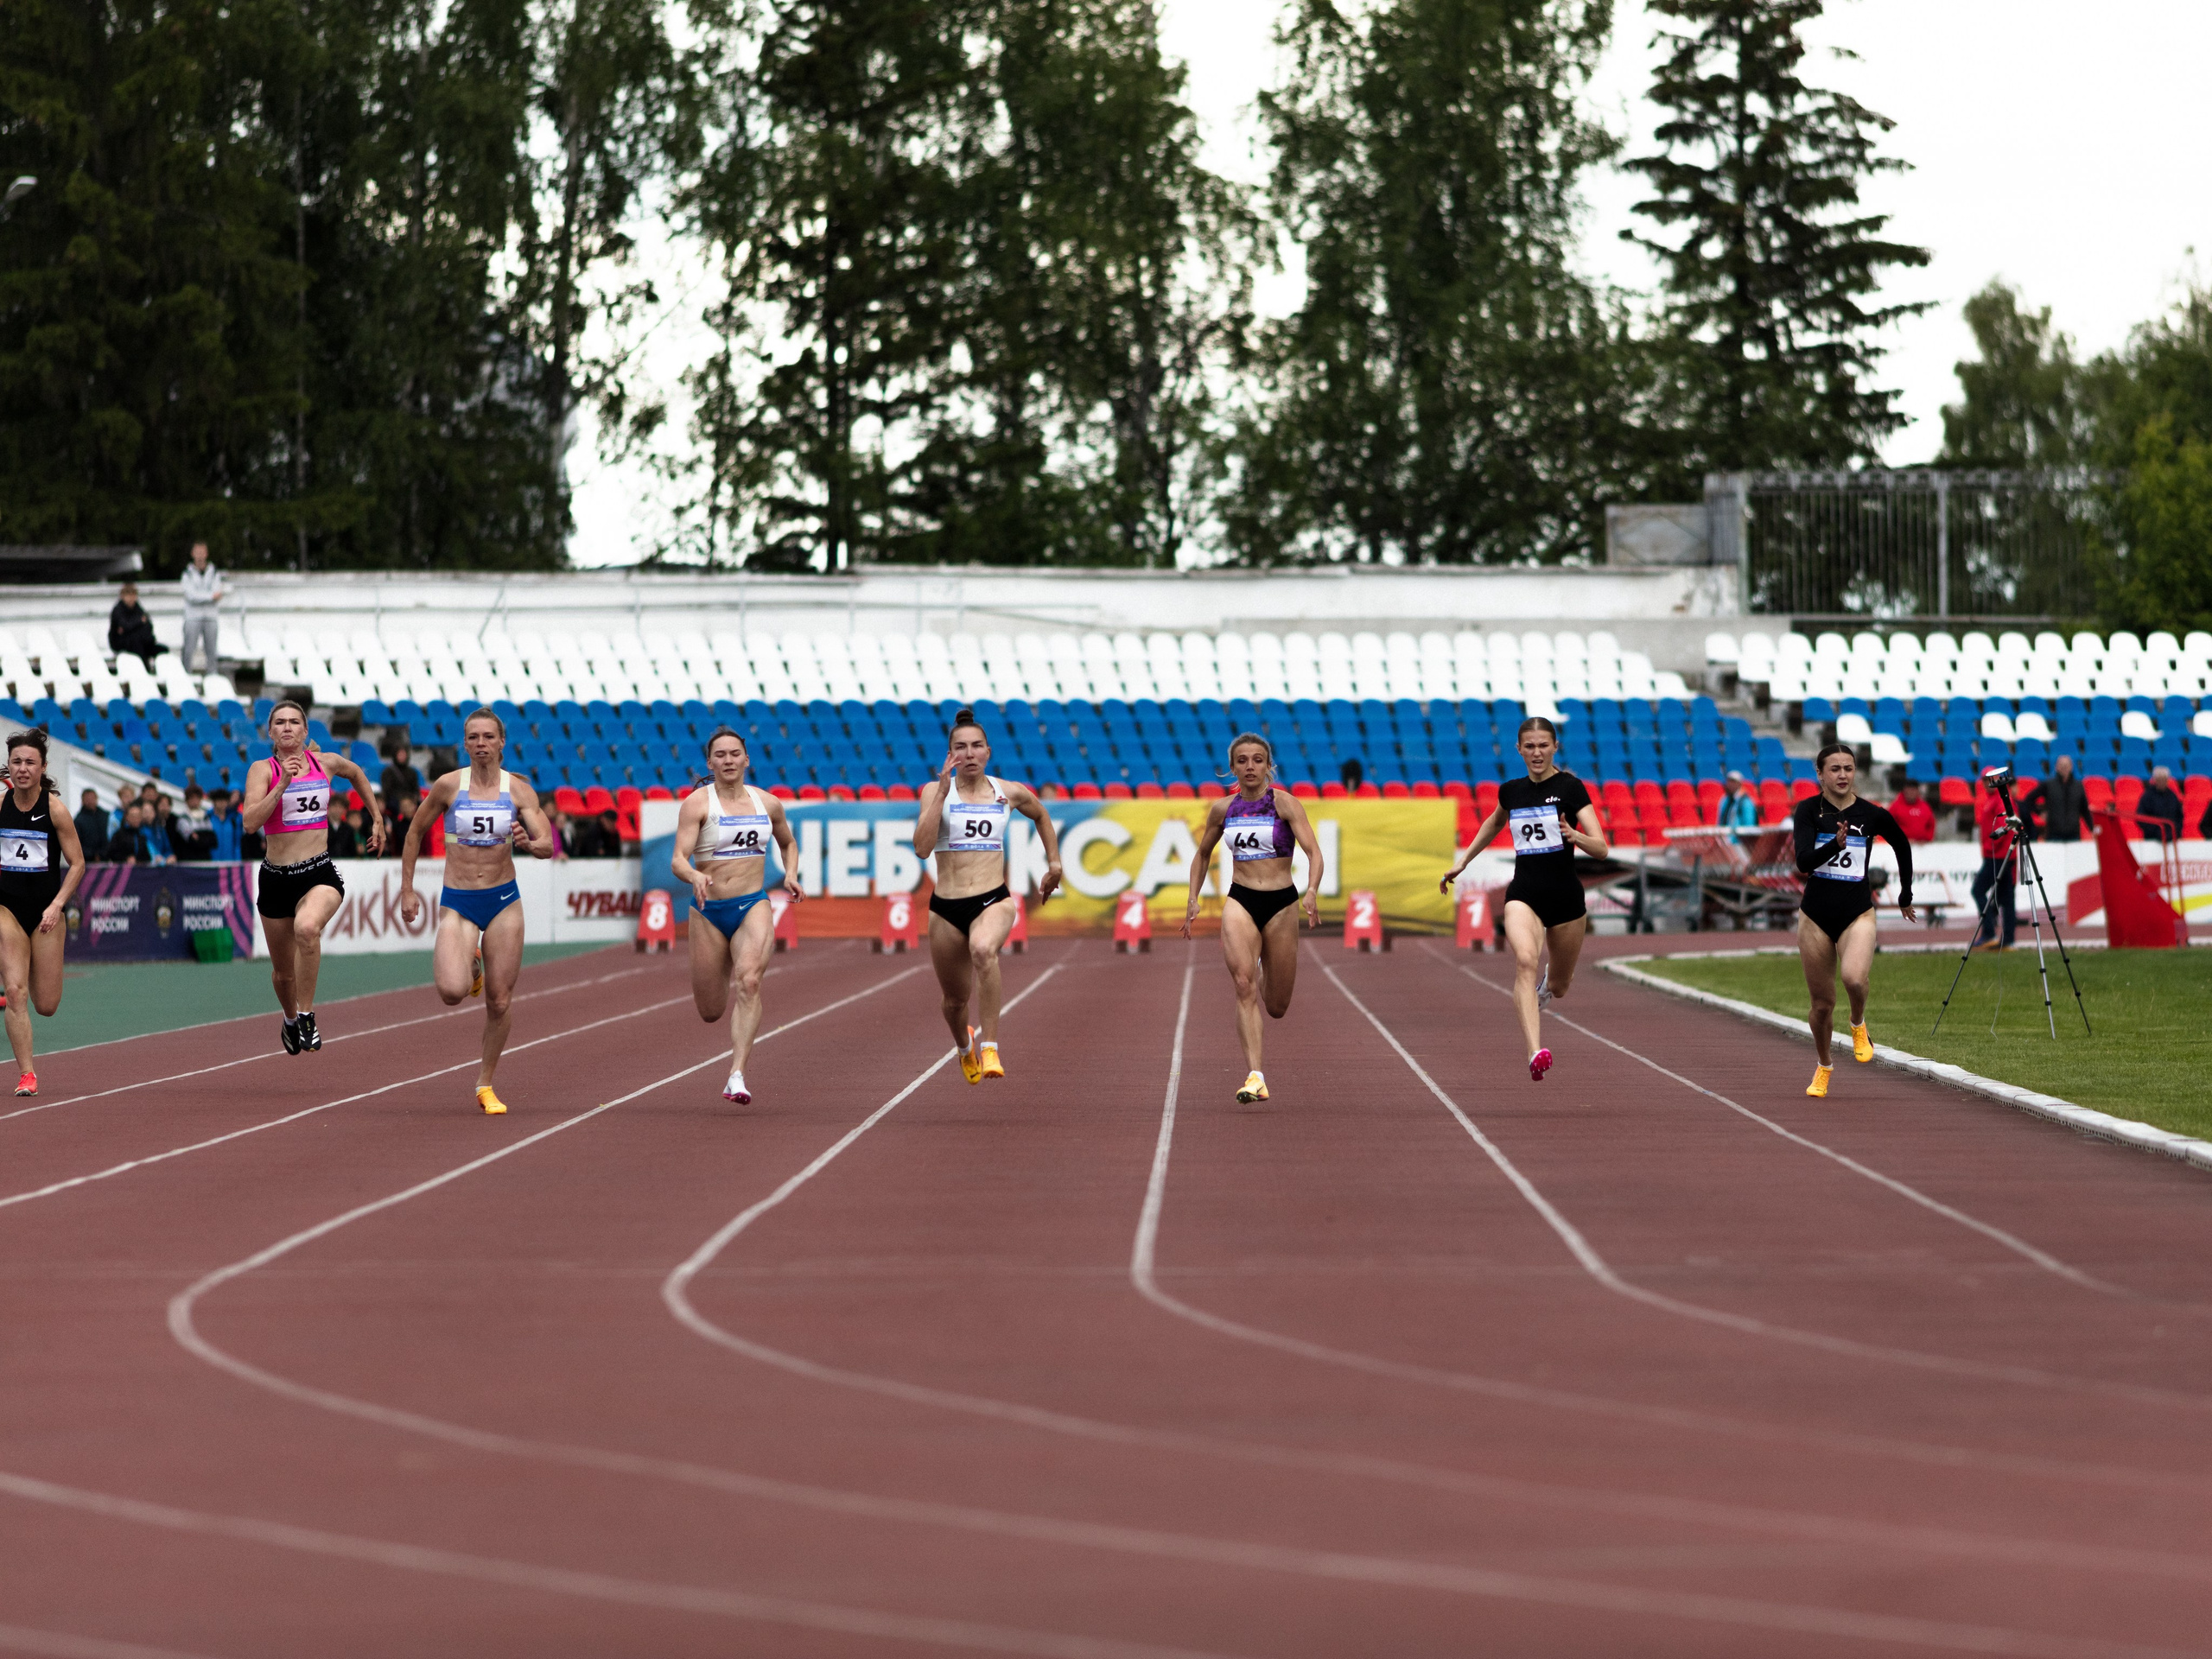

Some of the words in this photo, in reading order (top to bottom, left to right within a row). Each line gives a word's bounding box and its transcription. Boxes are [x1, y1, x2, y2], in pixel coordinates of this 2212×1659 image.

[296, 795, 321, 813] 36
[473, 816, 494, 835] 51
[964, 819, 993, 838] 50
[1521, 823, 1546, 842] 95
[732, 830, 759, 847] 48
[1234, 832, 1260, 849] 46
[16, 843, 29, 861] 4
[772, 817, 1338, 897] ЧЕБКСА
[1827, 852, 1852, 868] 26
[91, 895, 140, 912] МИНСПОРТ
[182, 893, 234, 911] МИНСПОРТ
[182, 914, 224, 931] РОССИИ
[646, 902, 668, 931] 8
[889, 902, 910, 930] 6
[1122, 901, 1143, 929] 4
[1352, 899, 1374, 928] 2
[1466, 900, 1484, 928] 1
[91, 917, 129, 933] РОССИИ
